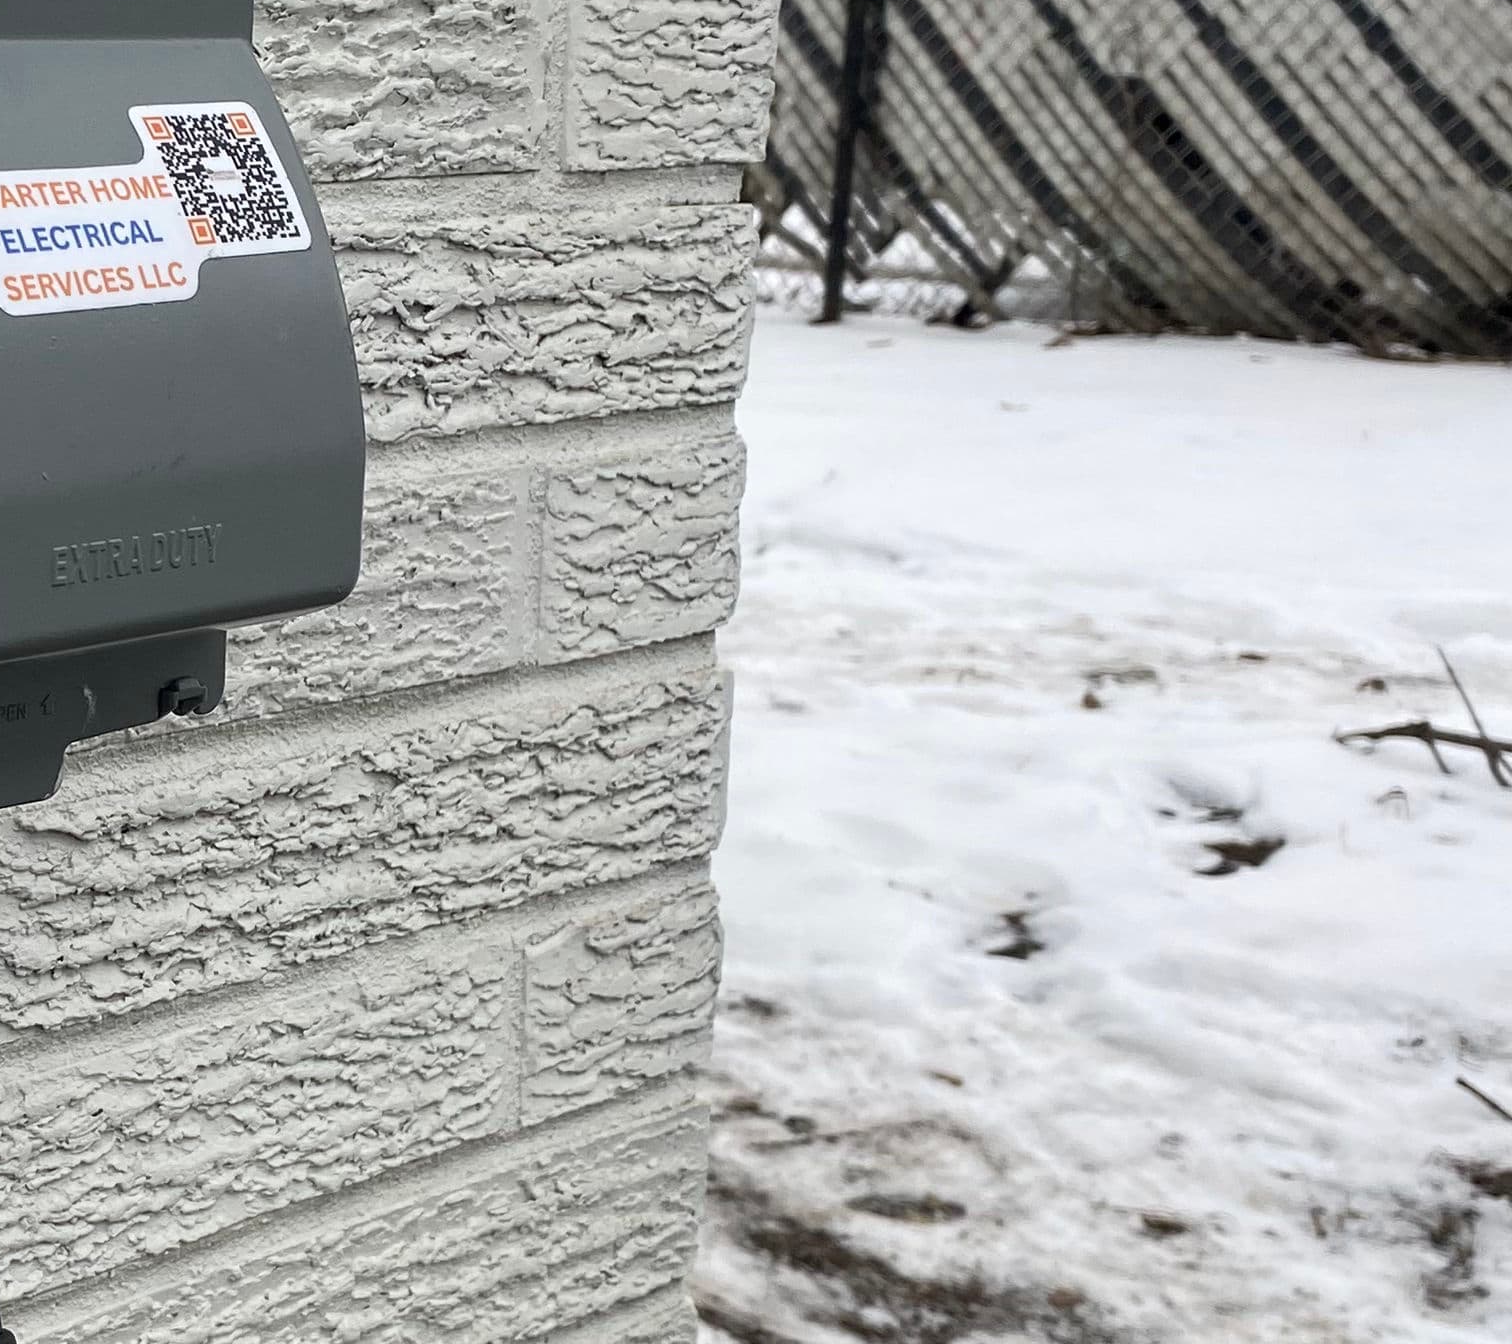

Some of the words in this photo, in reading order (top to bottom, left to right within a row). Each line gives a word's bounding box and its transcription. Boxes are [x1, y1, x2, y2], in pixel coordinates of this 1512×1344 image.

[90, 174, 173, 204] HOME
[0, 219, 164, 255] ELECTRICAL
[3, 264, 134, 302] SERVICES
[138, 261, 188, 290] LLC
[51, 536, 143, 588] EXTRA
[150, 523, 222, 573] DUTY
